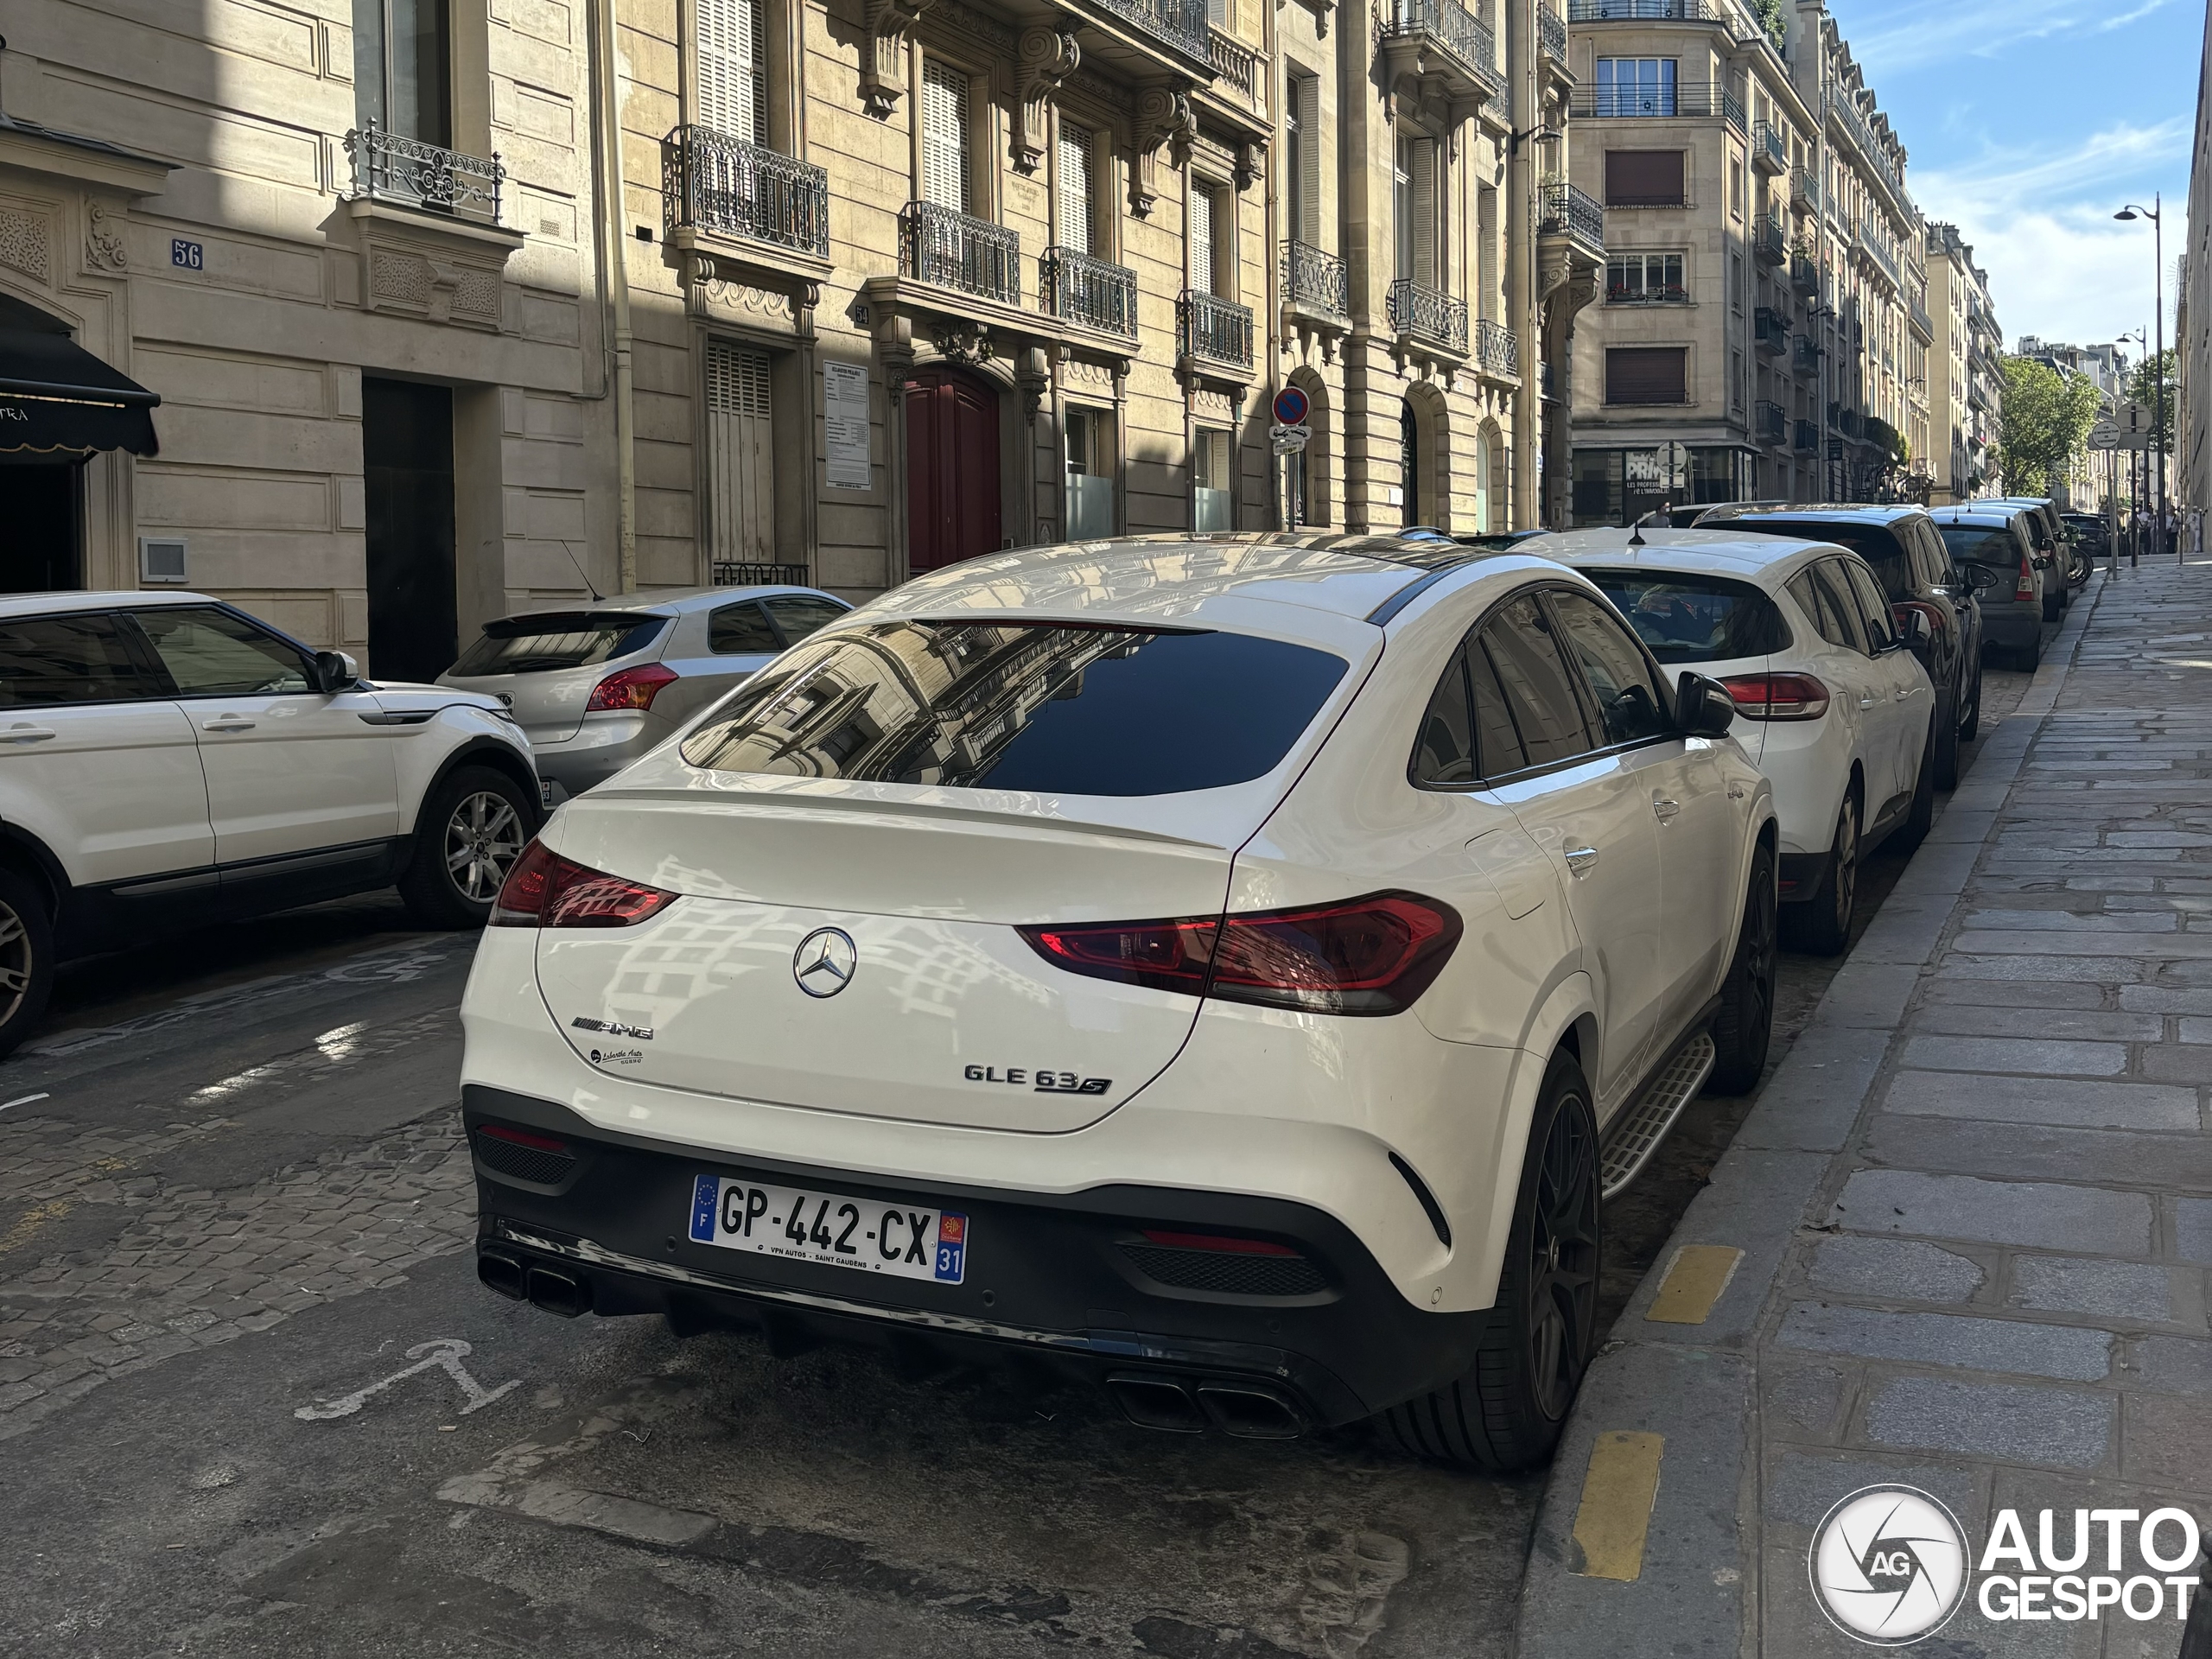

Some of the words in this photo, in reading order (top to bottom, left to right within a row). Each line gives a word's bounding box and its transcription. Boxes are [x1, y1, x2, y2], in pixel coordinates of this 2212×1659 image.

[175, 241, 200, 267] 56
[856, 307, 868, 324] 54
[599, 1021, 653, 1039] AMG
[627, 1048, 643, 1057] Auto
[964, 1064, 1027, 1084] GLE
[699, 1213, 709, 1227] F
[721, 1185, 931, 1266] GP-442-CX
[770, 1246, 784, 1255] VPN
[785, 1249, 807, 1259] AUTOS
[815, 1254, 835, 1263] SAINT
[836, 1257, 868, 1268] GAUDENS
[938, 1248, 960, 1274] 31
